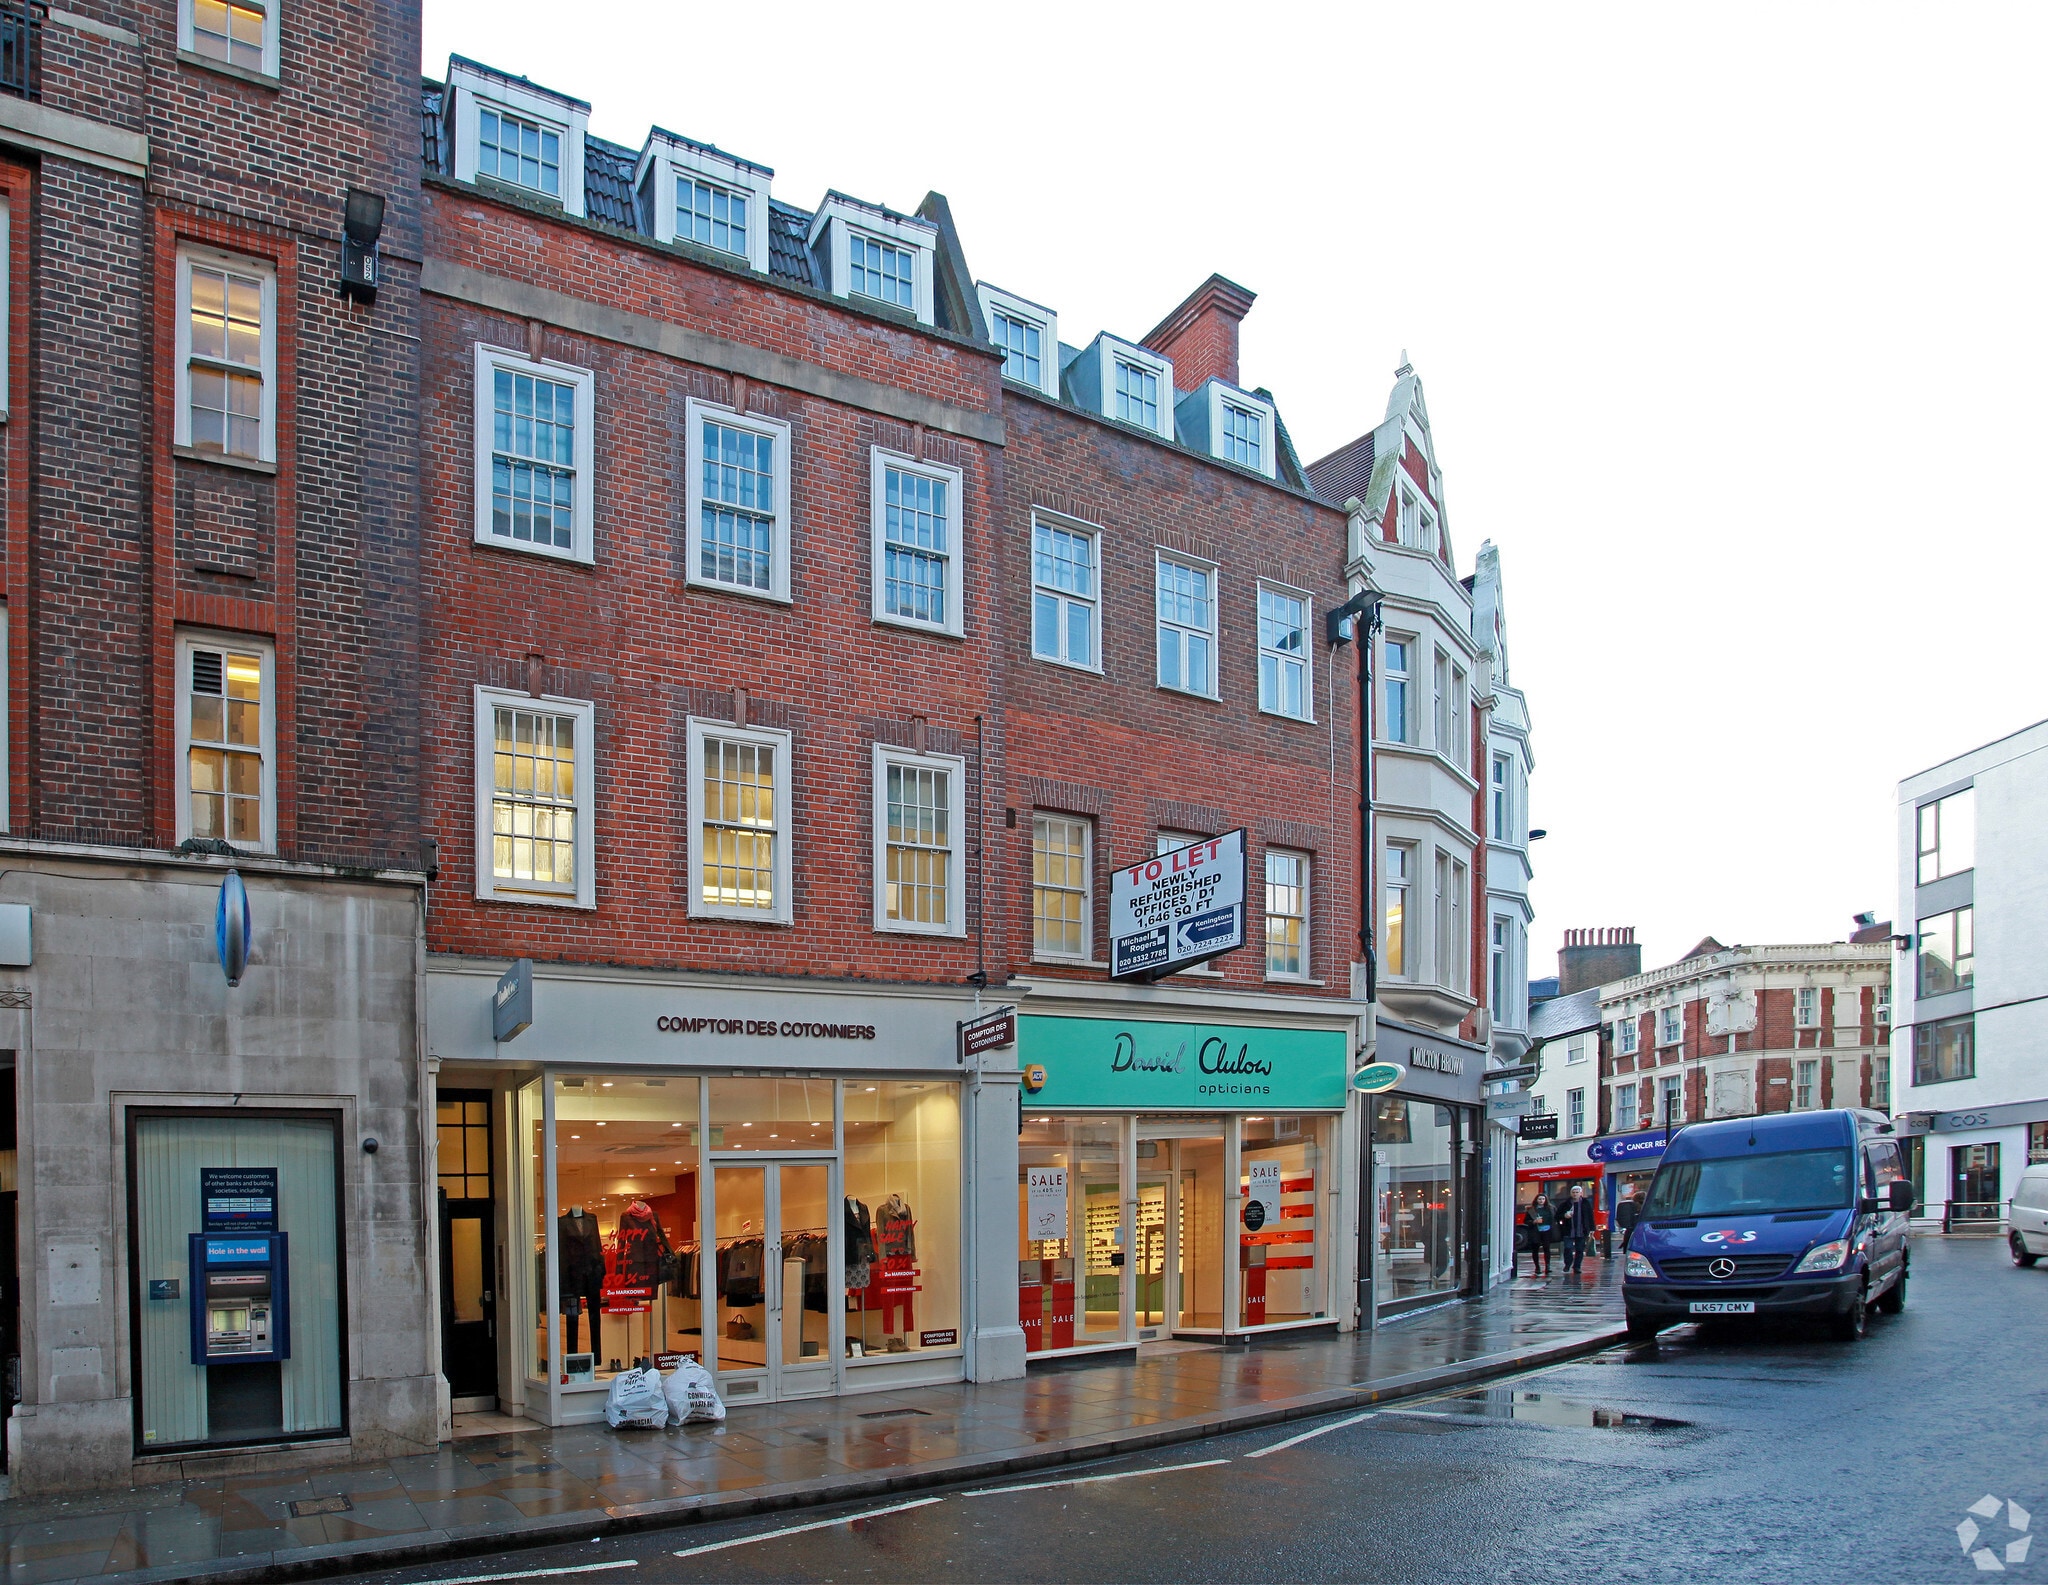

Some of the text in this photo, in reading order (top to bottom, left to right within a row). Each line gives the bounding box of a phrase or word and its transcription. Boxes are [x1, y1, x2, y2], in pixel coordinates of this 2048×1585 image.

[1128, 838, 1223, 886] TO LET
[1152, 868, 1198, 891] NEWLY
[1129, 873, 1222, 909] REFURBISHED
[1134, 894, 1187, 918] OFFICES
[1199, 886, 1215, 899] D1
[1137, 898, 1213, 928] 1,646 SQ FT
[1195, 912, 1233, 928] Keningtons
[1121, 932, 1150, 948] Michael
[1177, 934, 1234, 954] 020 7224 2222
[1130, 941, 1157, 953] Rogers
[1119, 948, 1167, 967] 020 8332 7788
[657, 1015, 876, 1040] COMPTOIR DES COTONNIERS
[967, 1021, 1008, 1041] COMPTOIR DES
[970, 1032, 1005, 1049] COTONNIERS
[1111, 1032, 1273, 1076] David Clulow
[1411, 1046, 1465, 1076] MOLTON BROWN
[1198, 1083, 1271, 1096] opticians
[233, 1092, 242, 1105] 7
[1949, 1112, 1988, 1127] COS
[1525, 1124, 1555, 1132] LINKS
[1626, 1139, 1667, 1151] CANCER RES
[1524, 1152, 1559, 1165] BENNETT
[1253, 1166, 1278, 1178] SALE
[1031, 1174, 1063, 1187] SALE
[885, 1220, 918, 1231] HAPPY
[609, 1228, 649, 1241] HAPPY
[879, 1232, 904, 1244] SALE
[1700, 1230, 1757, 1244] G4S
[250, 1246, 266, 1254] wall
[600, 1242, 632, 1256] SALE
[1248, 1295, 1266, 1304] SALE
[1694, 1303, 1749, 1312] LK57 CMY
[1019, 1319, 1042, 1328] SALE
[1052, 1314, 1074, 1324] SALE
[924, 1332, 946, 1340] COMPTOIR
[926, 1337, 952, 1345] COTONNIERS
